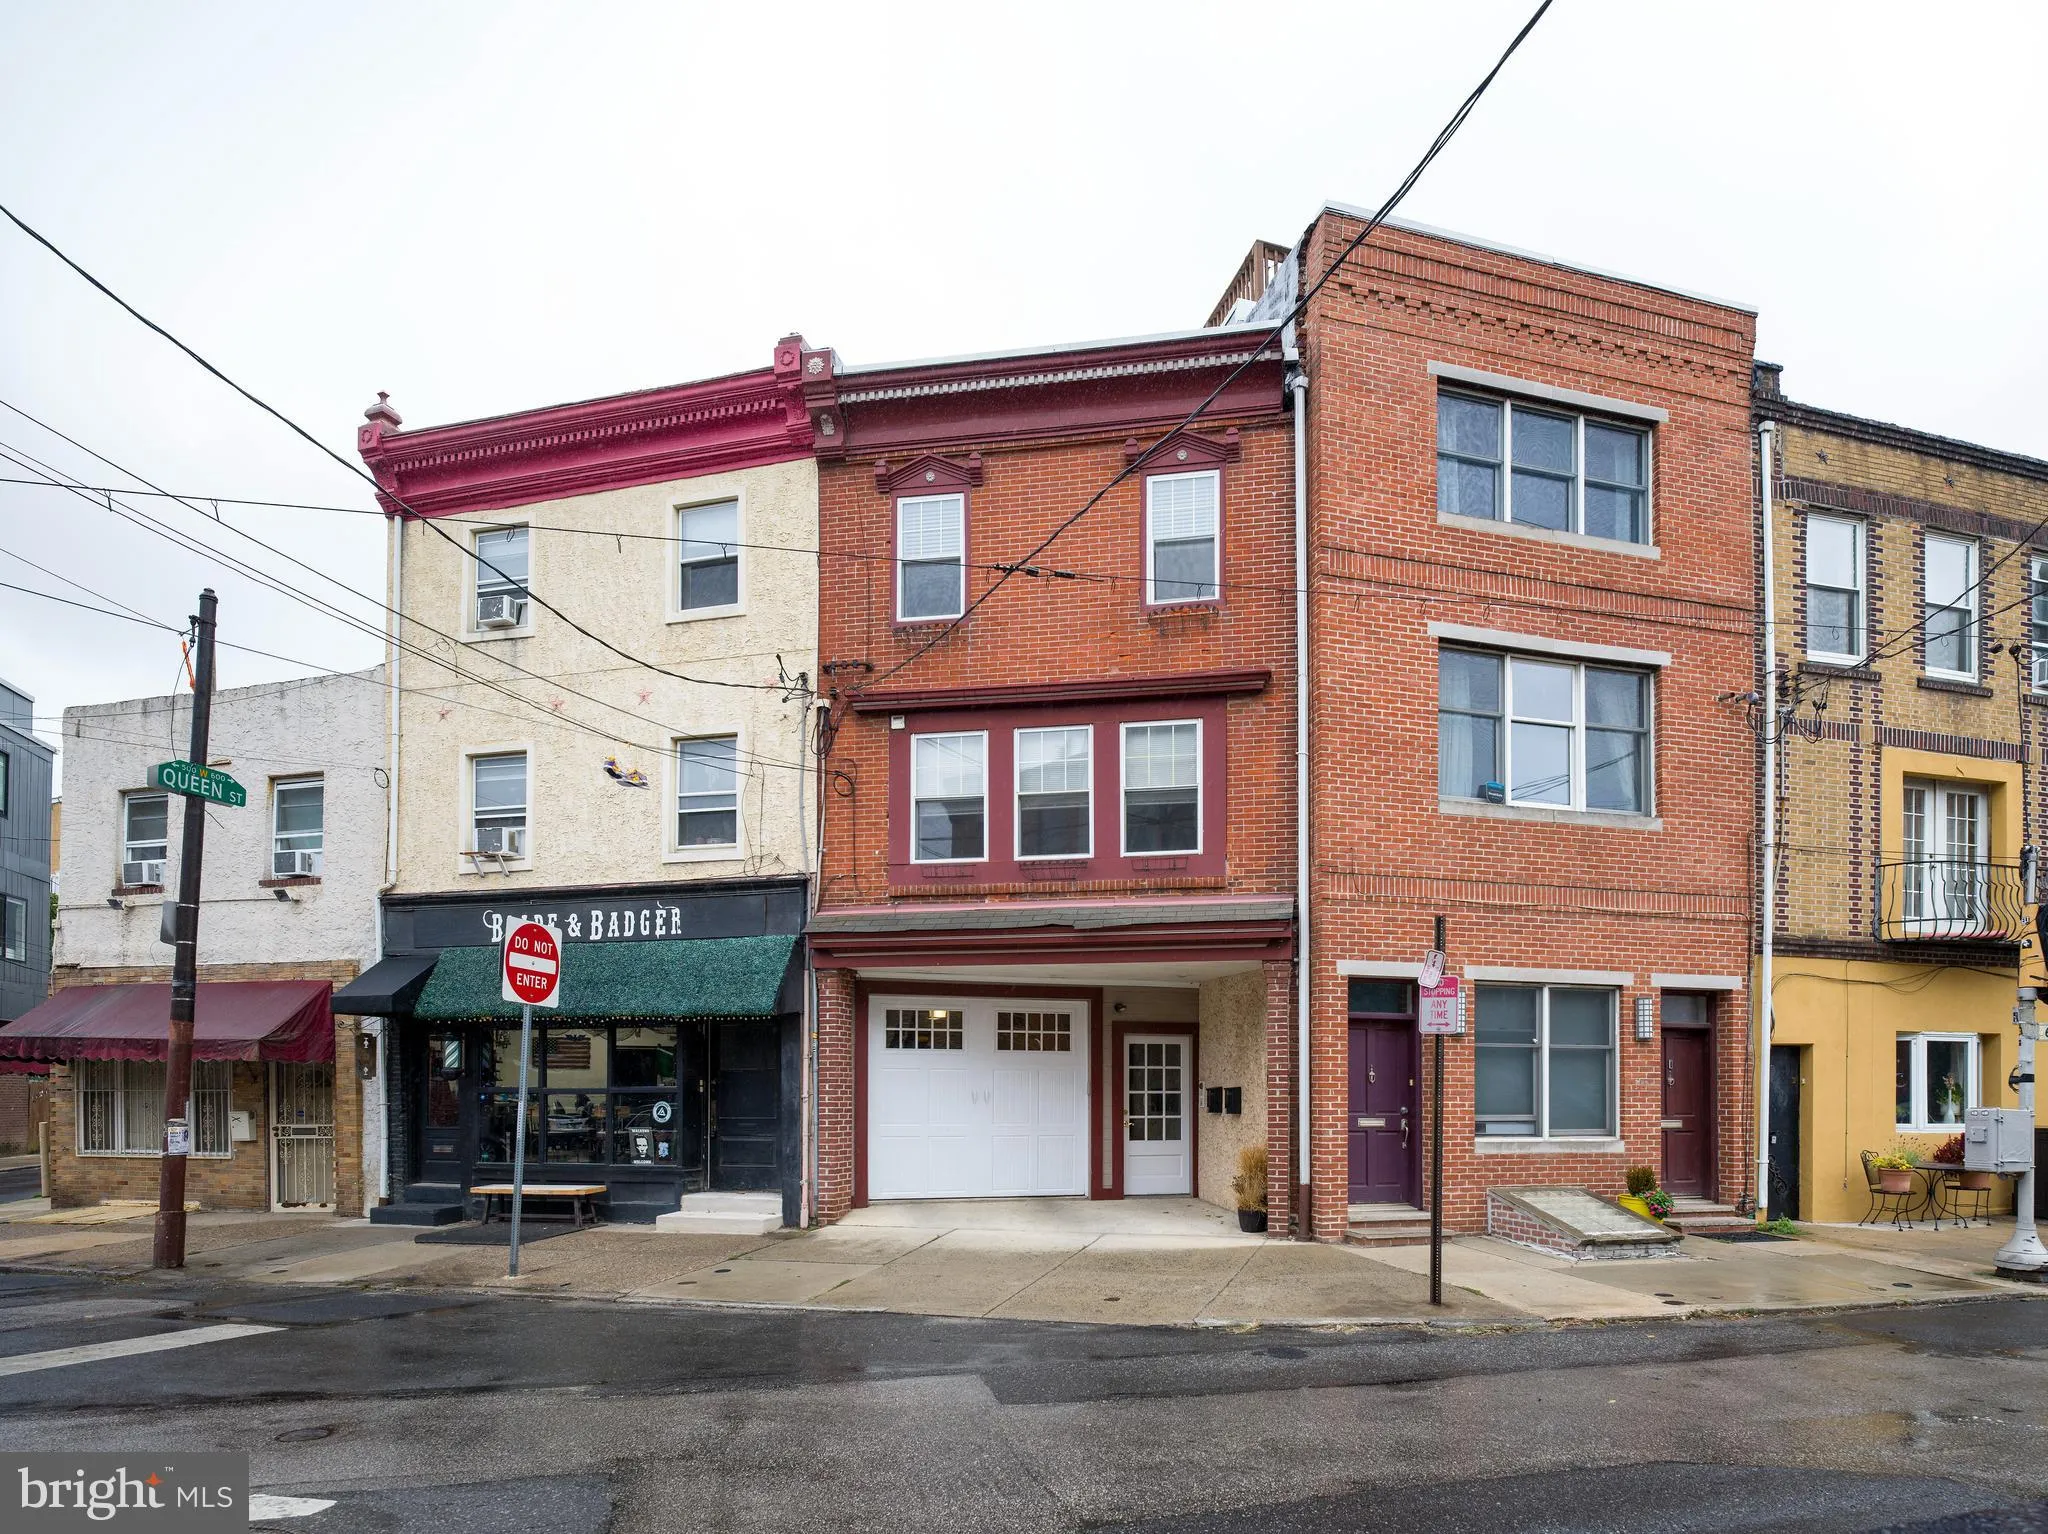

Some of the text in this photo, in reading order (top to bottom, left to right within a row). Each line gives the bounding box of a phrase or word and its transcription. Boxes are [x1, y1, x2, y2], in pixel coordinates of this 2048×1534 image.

[181, 764, 226, 782] 500 W 600
[163, 768, 243, 804] QUEEN ST
[564, 913, 582, 937] &
[514, 936, 553, 956] DO NOT
[516, 972, 548, 990] ENTER
[1423, 987, 1456, 996] STOPPING
[1431, 1000, 1447, 1009] ANY
[1431, 1010, 1448, 1019] TIME
